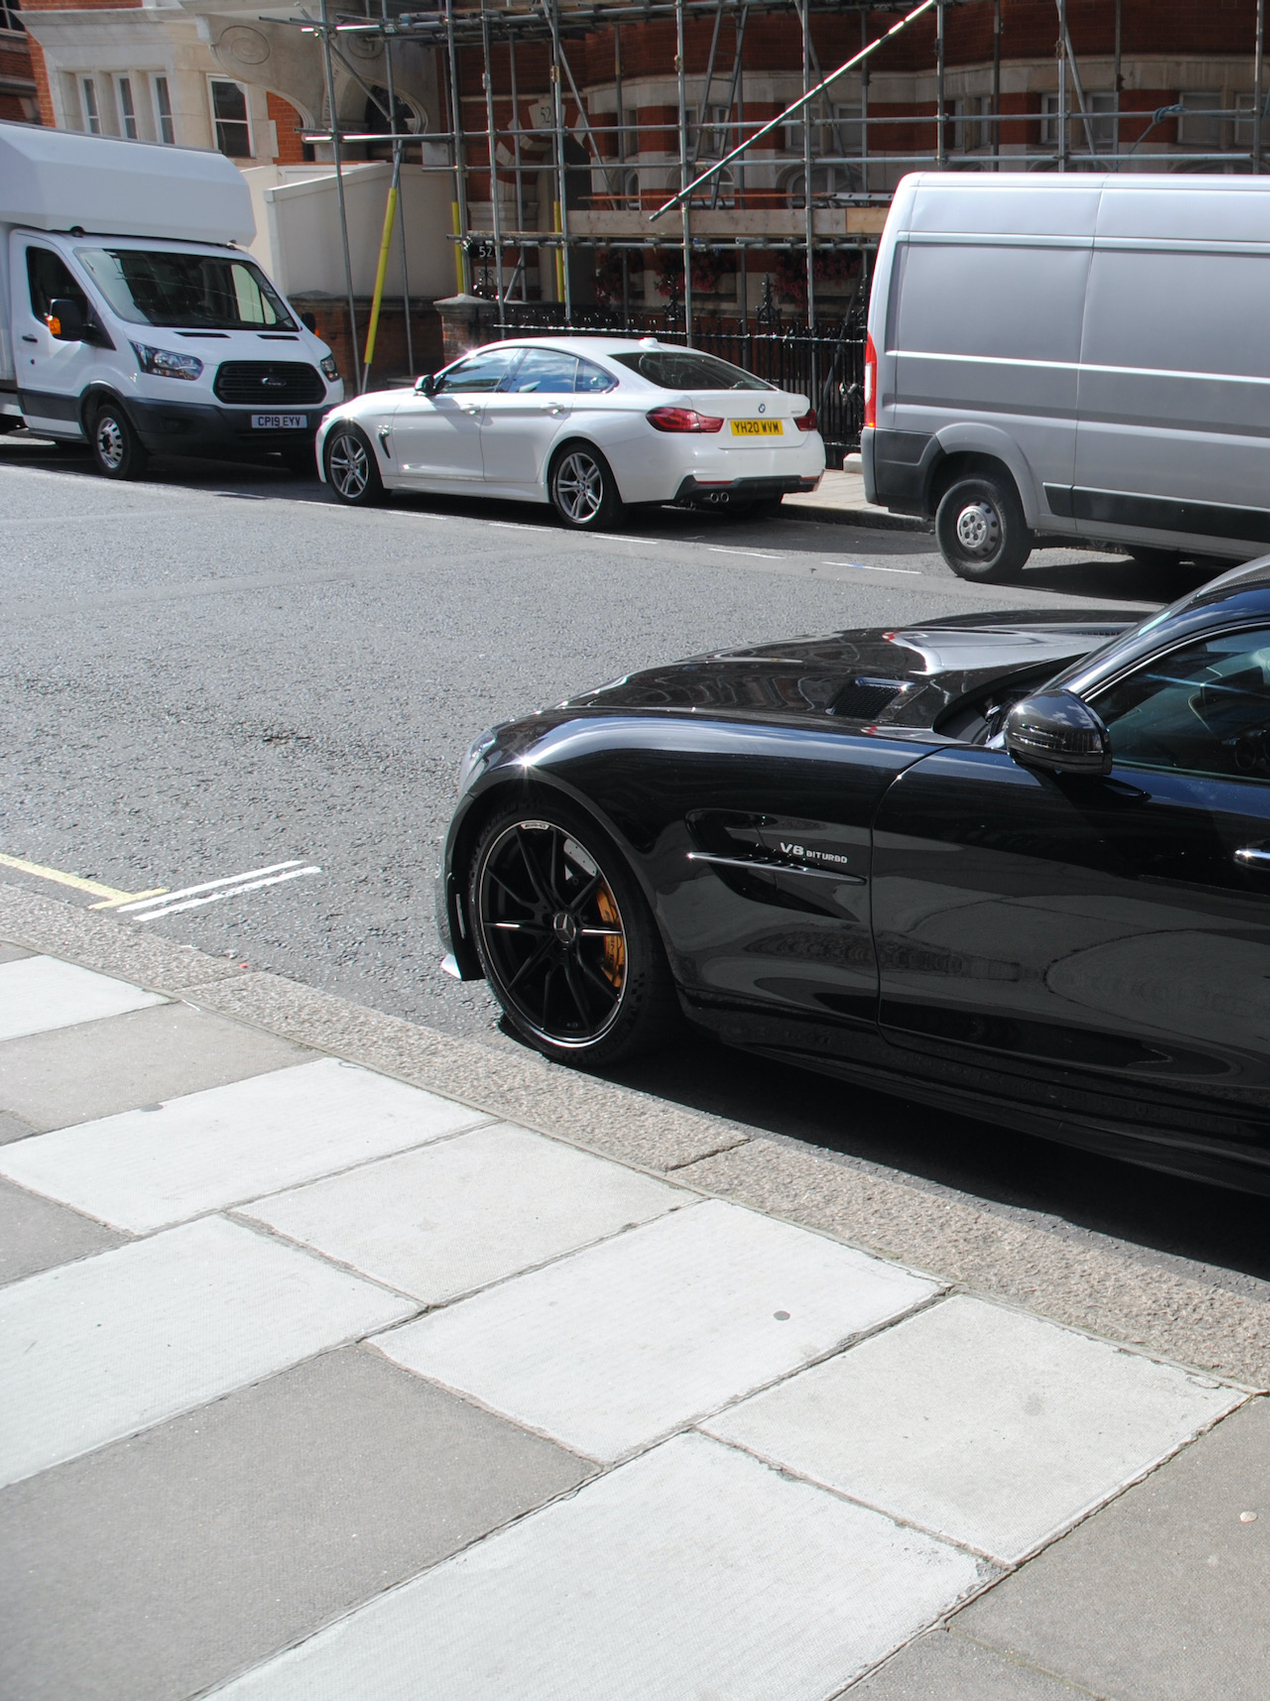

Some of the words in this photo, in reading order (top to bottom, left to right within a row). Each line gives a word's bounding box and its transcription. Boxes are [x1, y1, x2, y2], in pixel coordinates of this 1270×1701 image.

[540, 106, 551, 124] 52
[479, 245, 492, 258] 52
[258, 416, 281, 427] CP19
[283, 416, 301, 428] EYV
[734, 422, 760, 434] YH20
[780, 842, 805, 856] V8
[806, 850, 848, 864] BITURBO
